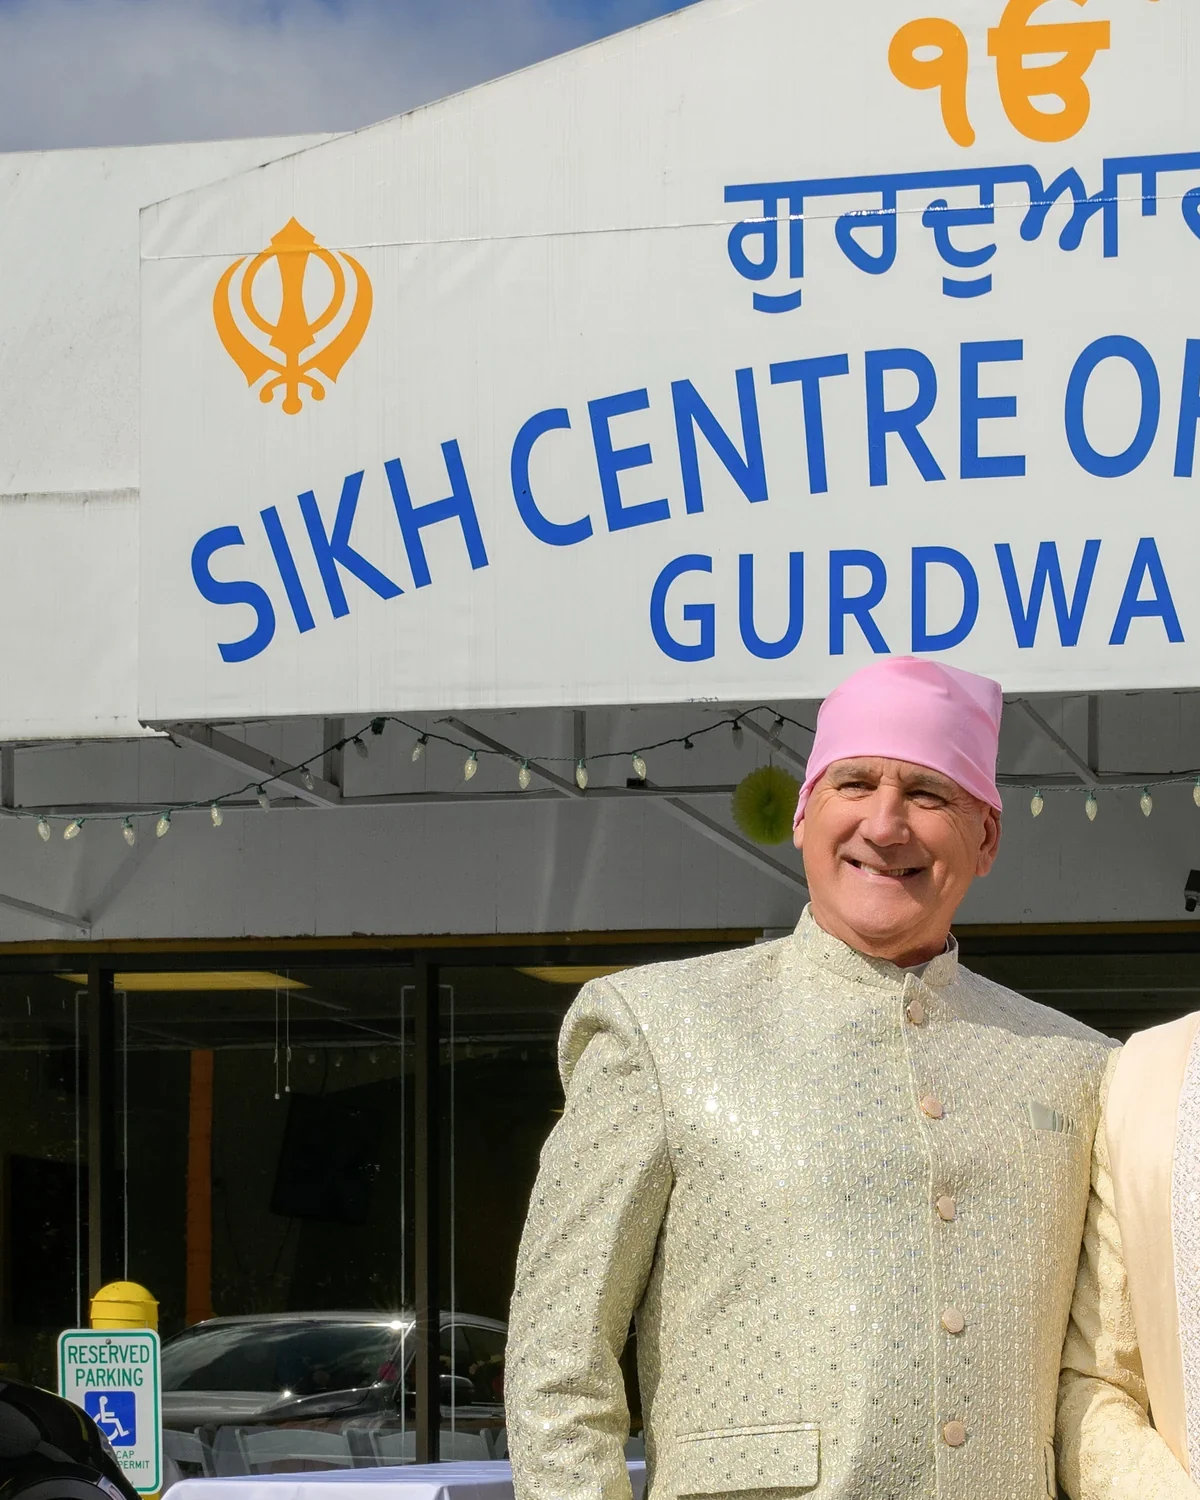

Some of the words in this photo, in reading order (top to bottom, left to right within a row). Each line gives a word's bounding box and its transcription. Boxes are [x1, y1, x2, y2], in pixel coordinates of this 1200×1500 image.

[191, 439, 489, 663] SIKH
[510, 339, 1026, 547] CENTRE
[68, 1345, 150, 1364] RESERVED
[75, 1368, 144, 1387] PARKING
